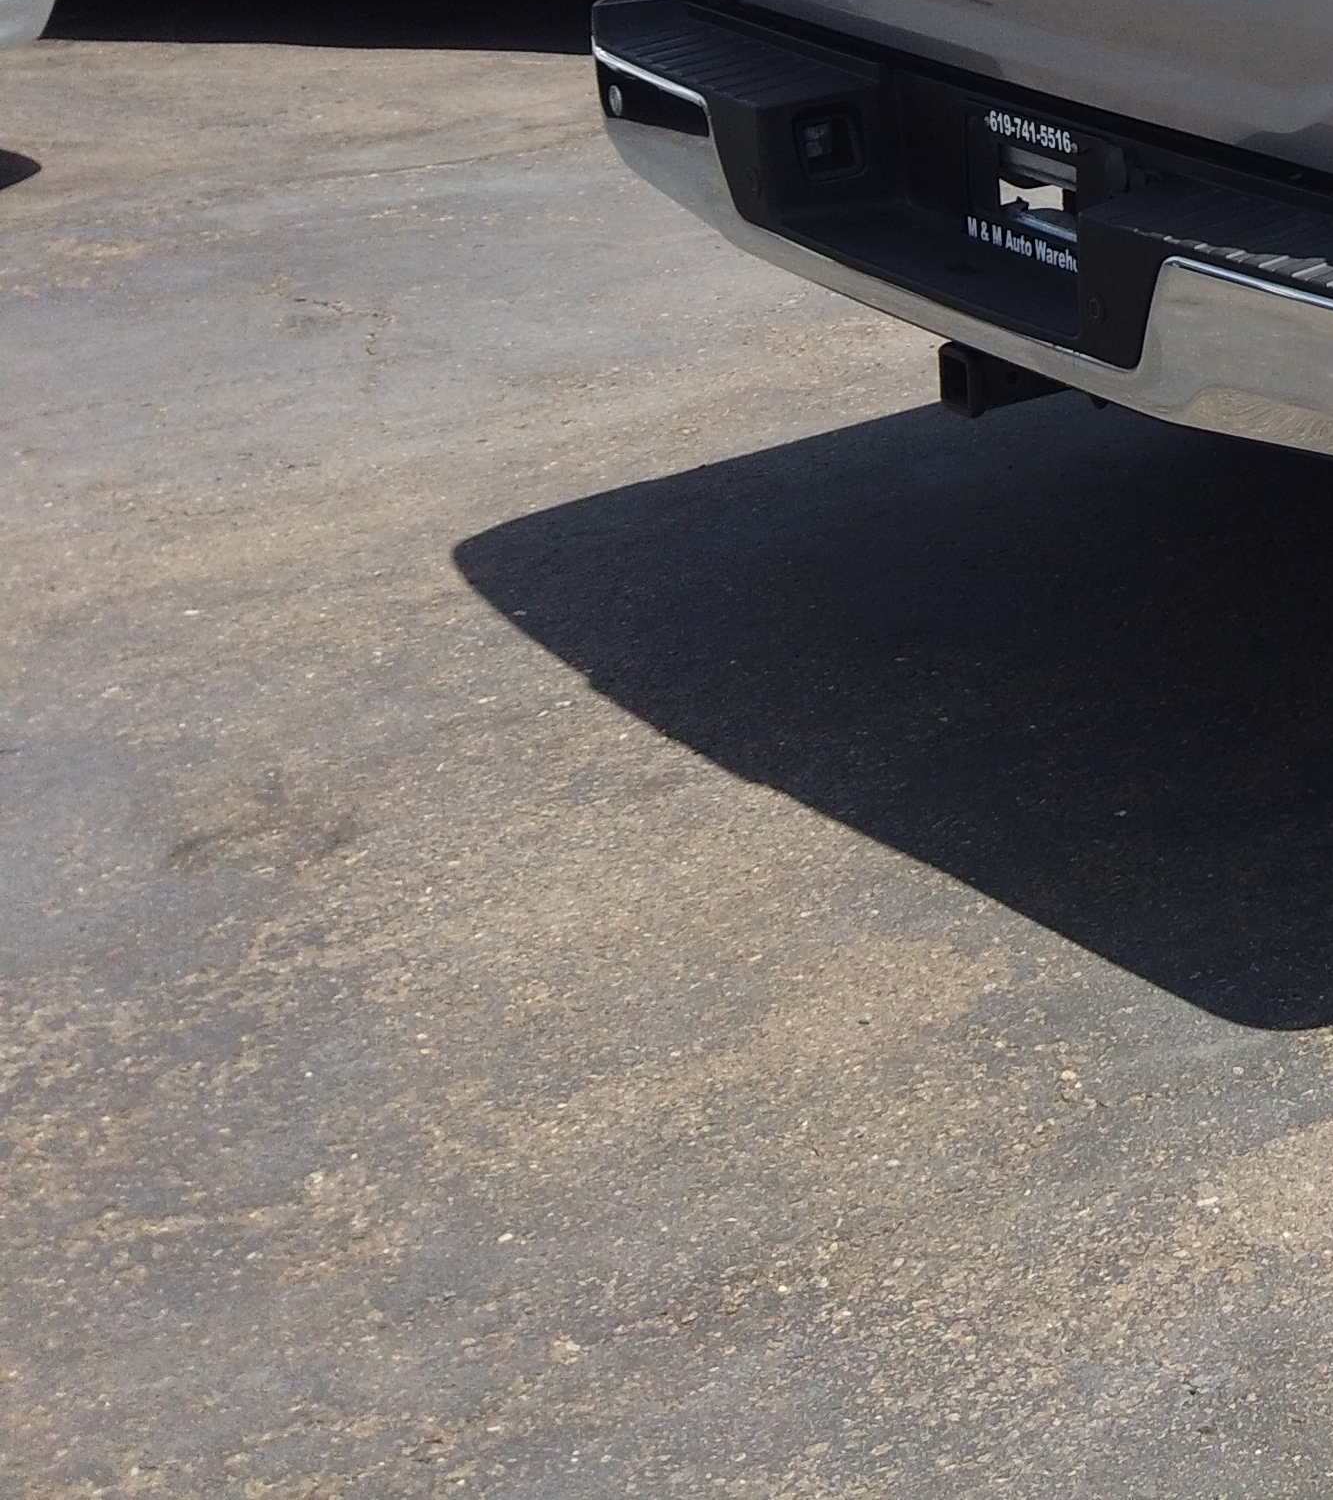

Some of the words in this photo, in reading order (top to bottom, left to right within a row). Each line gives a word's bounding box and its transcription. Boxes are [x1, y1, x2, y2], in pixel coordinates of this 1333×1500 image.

[989, 109, 1072, 154] 619-741-5516
[967, 215, 977, 238] M
[980, 221, 990, 243] &
[992, 223, 1002, 247] M
[1005, 229, 1032, 257] Auto
